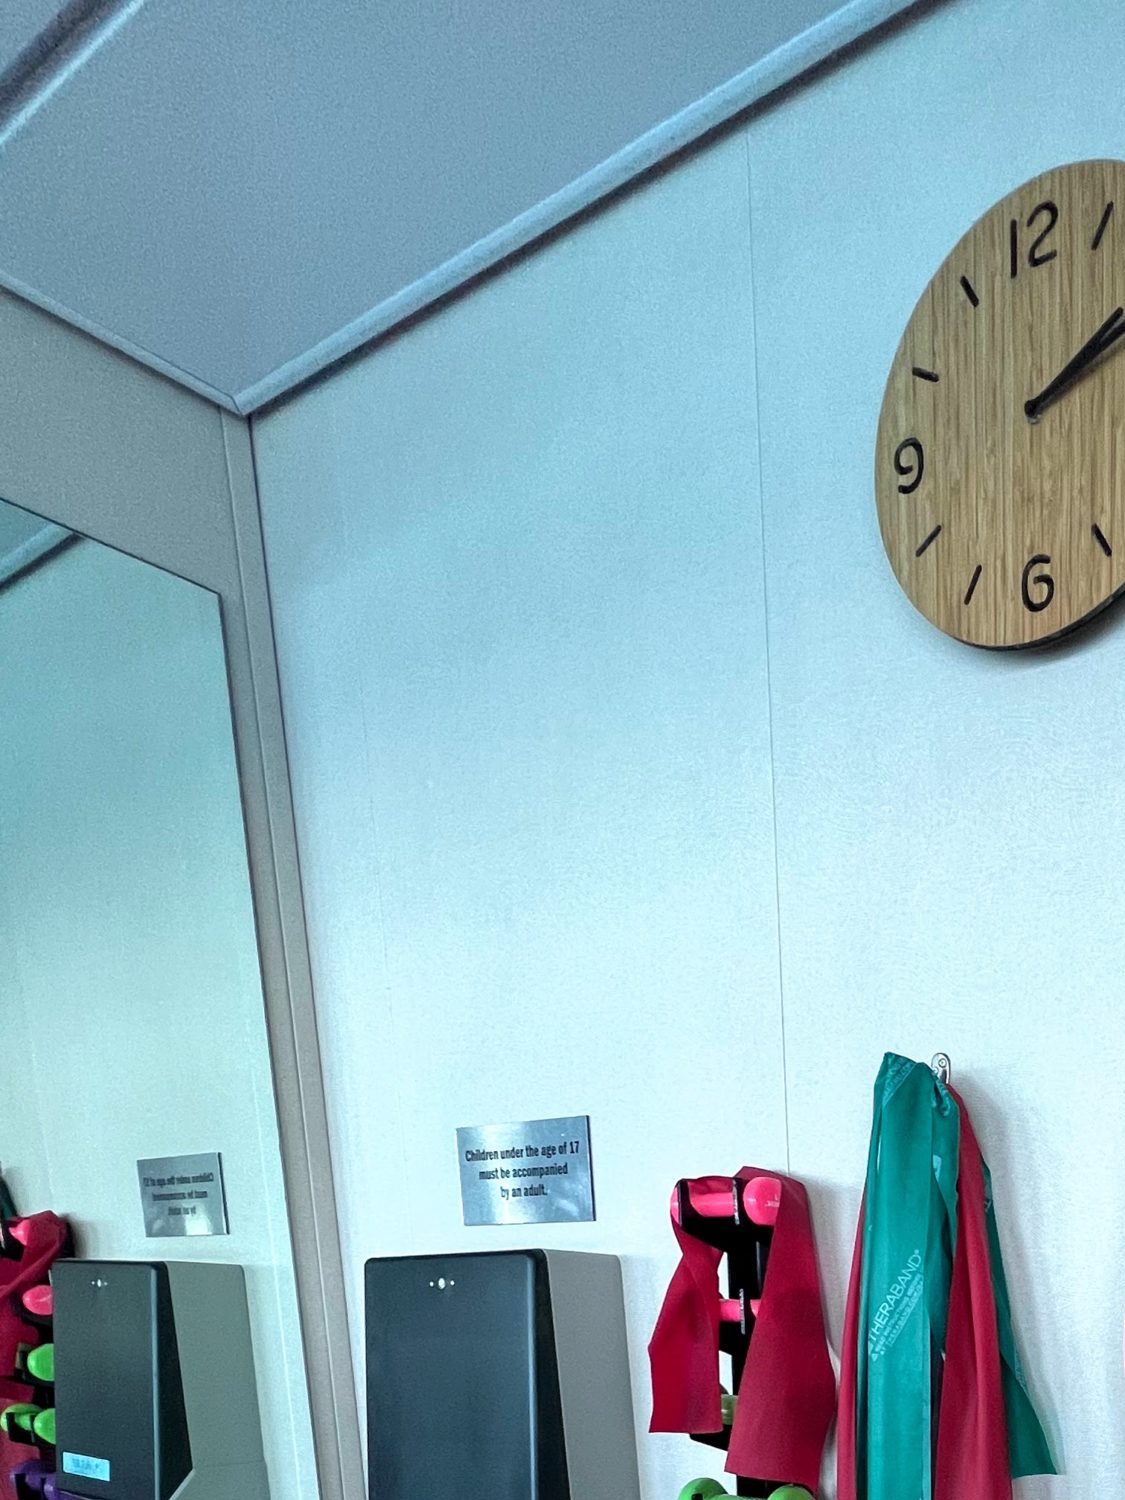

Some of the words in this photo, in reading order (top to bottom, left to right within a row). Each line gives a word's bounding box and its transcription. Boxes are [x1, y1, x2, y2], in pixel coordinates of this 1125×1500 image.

[1010, 201, 1058, 278] 12
[894, 437, 924, 494] 9
[1021, 555, 1054, 612] 6
[465, 1149, 499, 1162] Children
[500, 1147, 524, 1160] under
[525, 1145, 539, 1158] the
[541, 1145, 556, 1159] age
[558, 1141, 567, 1155] of
[569, 1141, 580, 1154] 17
[479, 1168, 499, 1180] must
[500, 1166, 510, 1179] be
[512, 1162, 568, 1180] accompanied
[500, 1186, 509, 1200] by
[511, 1187, 522, 1197] an
[523, 1183, 548, 1197] adult.
